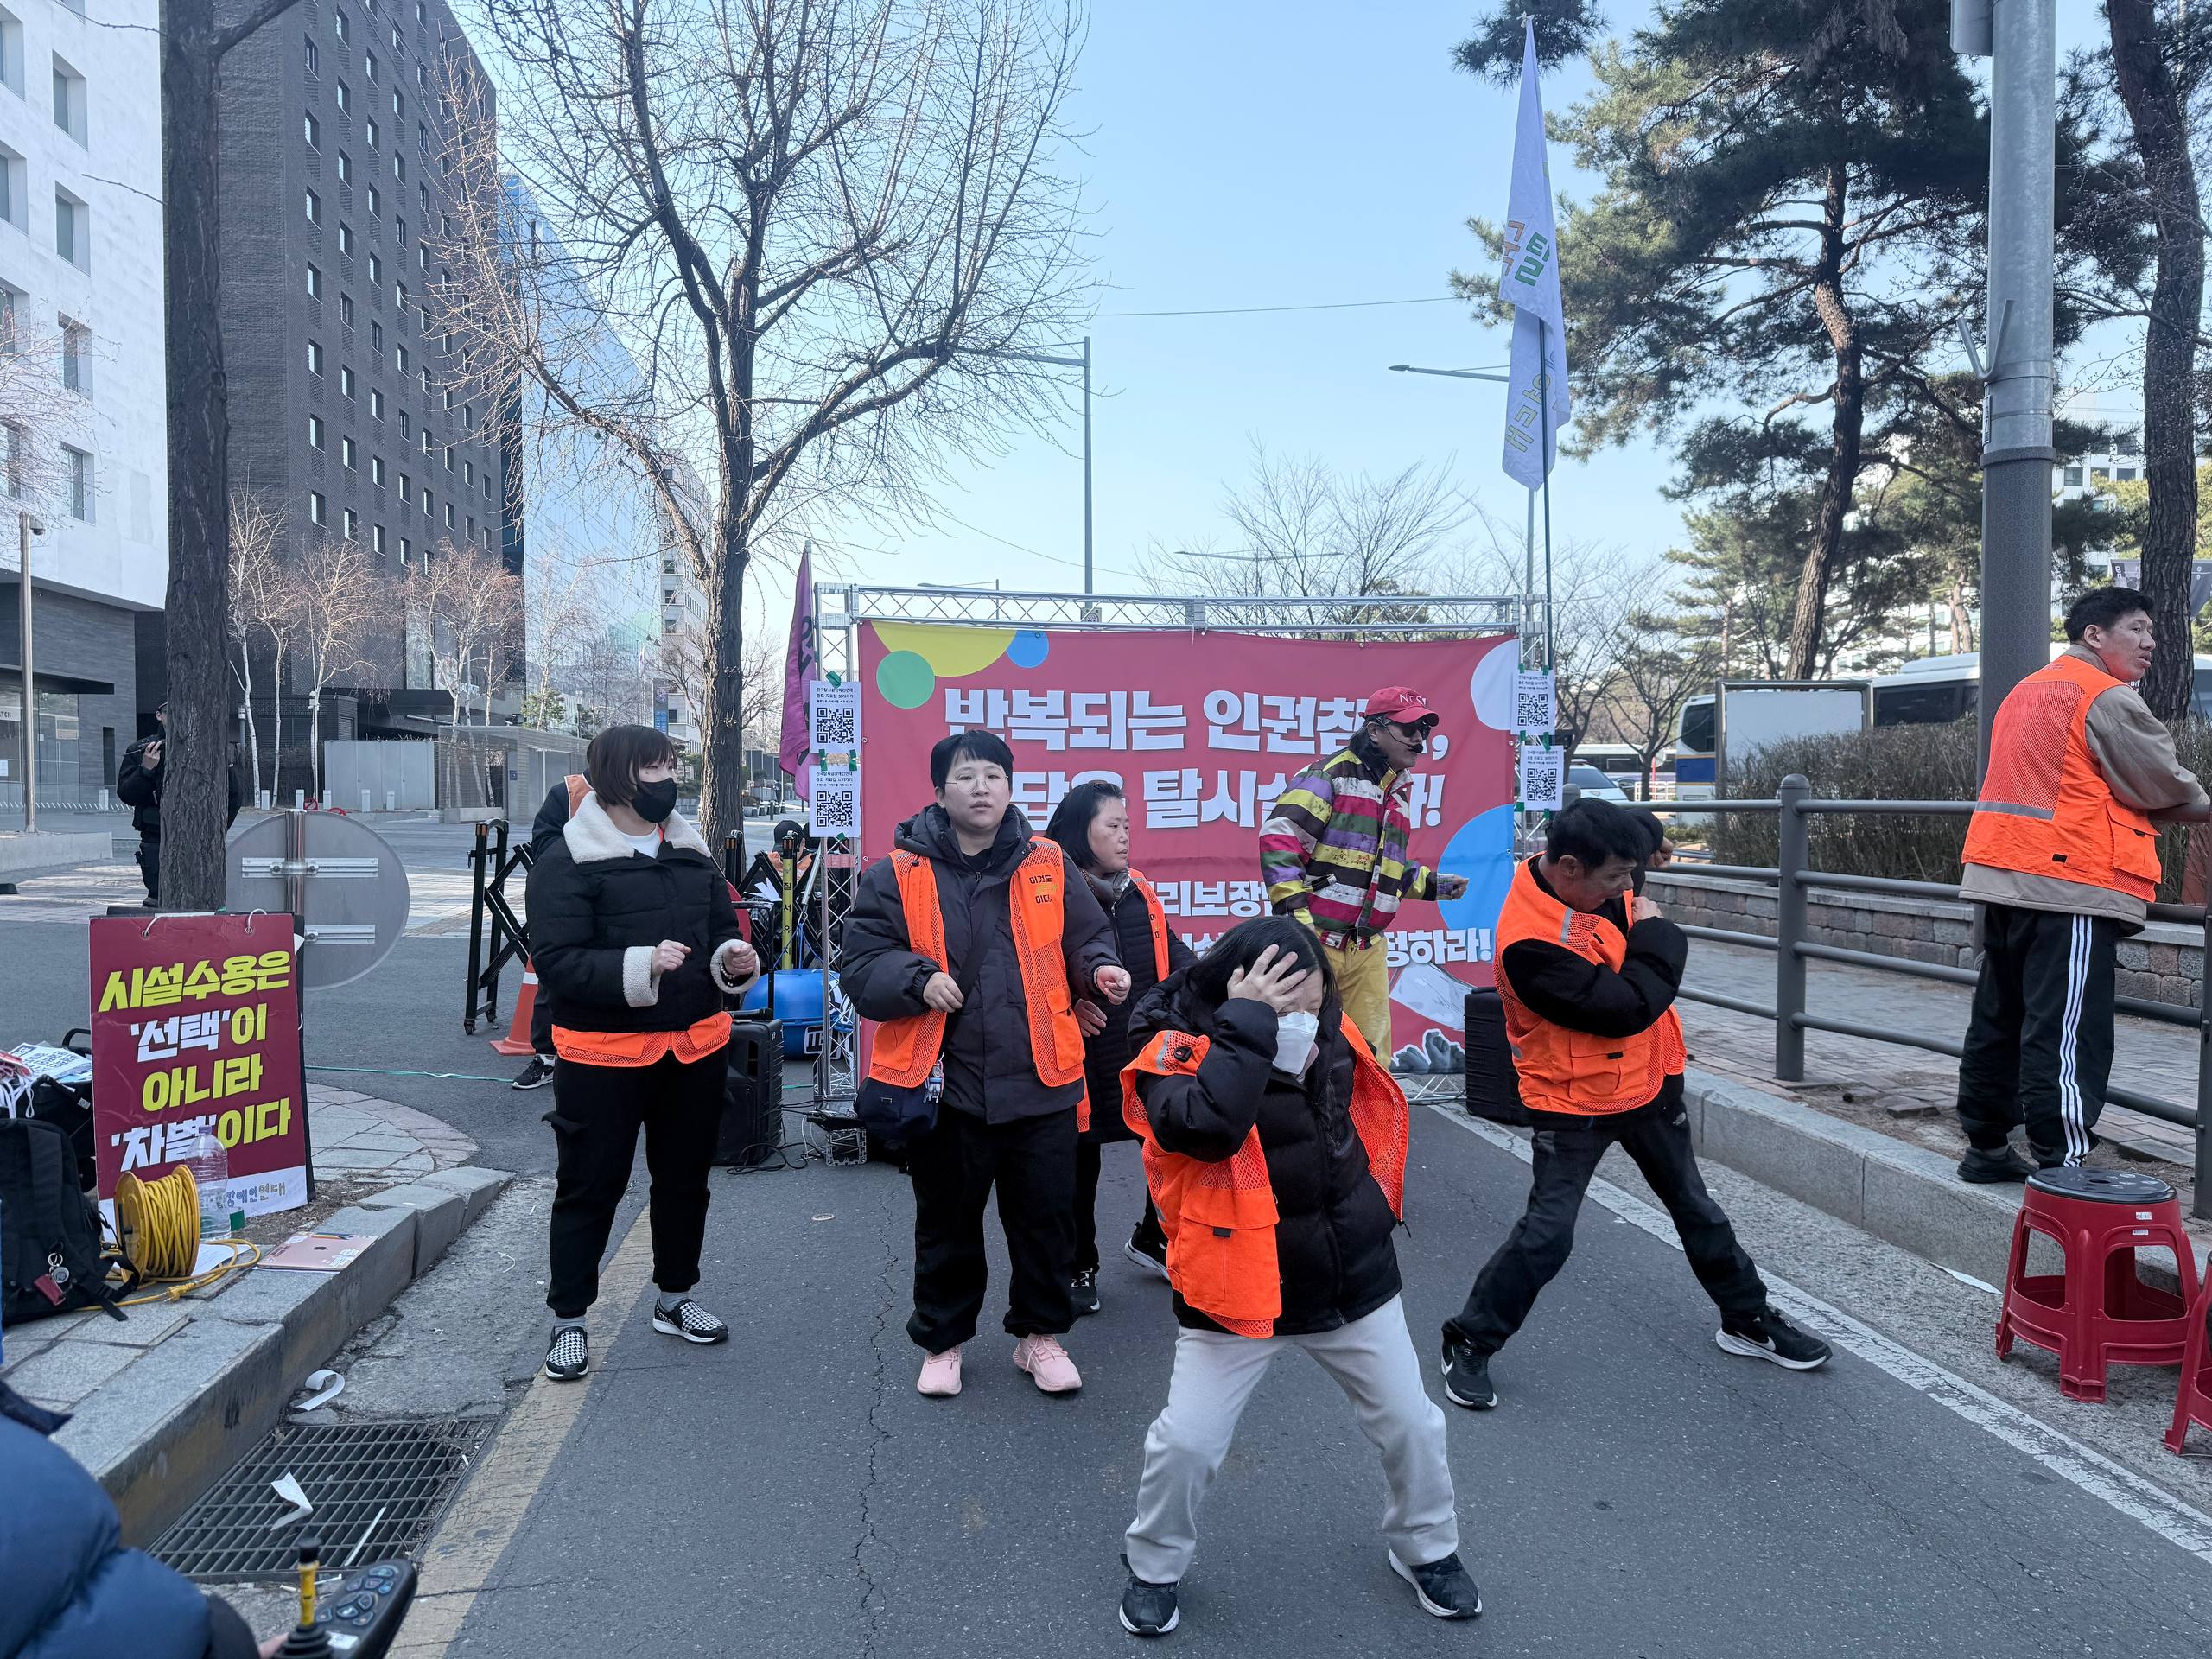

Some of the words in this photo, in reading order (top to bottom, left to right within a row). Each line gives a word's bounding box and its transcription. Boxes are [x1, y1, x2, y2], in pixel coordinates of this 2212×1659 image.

[944, 688, 1187, 751] 반복되는
[1202, 690, 1450, 761] 인권침,
[1383, 927, 1492, 968] 정하라!
[98, 950, 291, 1013] 시설수용은
[130, 1002, 268, 1063] '선택'이
[143, 1052, 264, 1112] 아니라
[111, 1097, 292, 1173] '차별'이다
